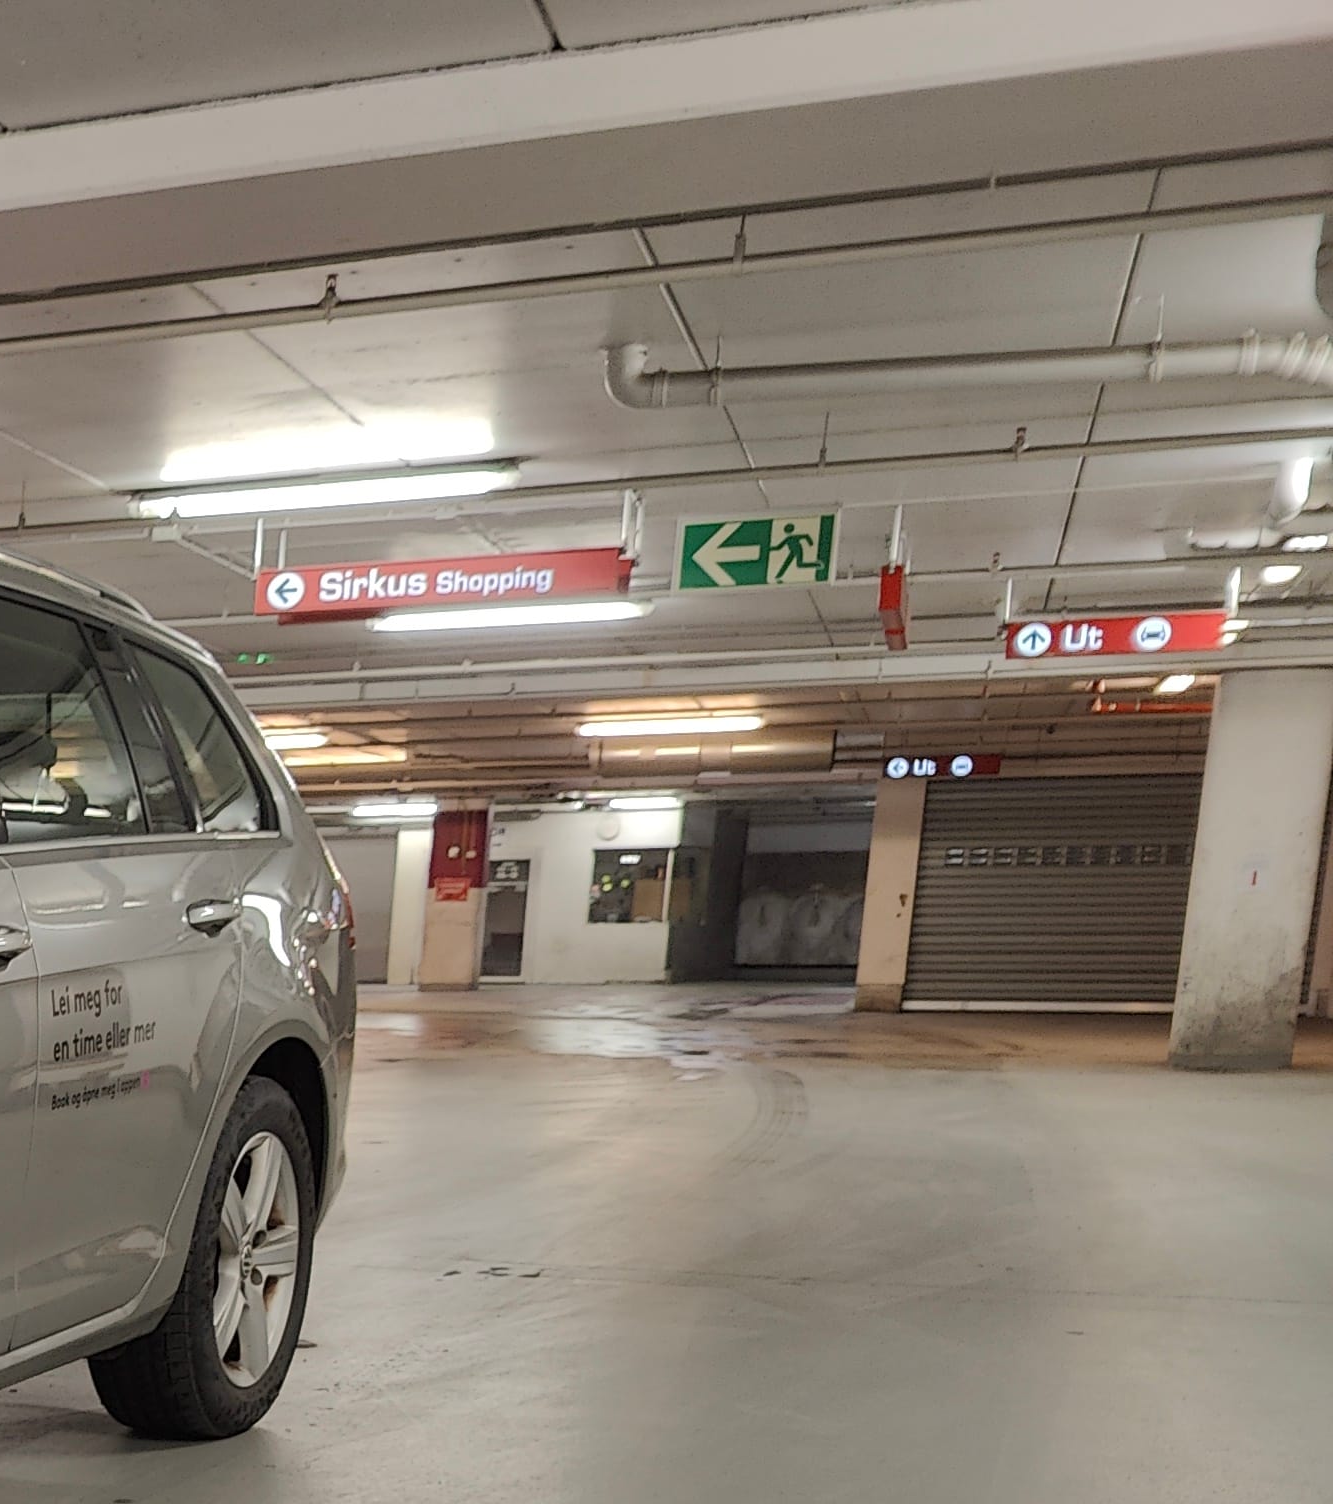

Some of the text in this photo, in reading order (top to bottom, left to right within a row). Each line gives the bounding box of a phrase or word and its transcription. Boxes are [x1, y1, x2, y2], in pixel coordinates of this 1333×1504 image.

[318, 565, 555, 602] Sirkus Shopping
[1061, 622, 1104, 653] Ut
[51, 979, 122, 1018] Lei meg for
[53, 1021, 156, 1062] en time eller mer
[51, 1092, 69, 1111] Book
[71, 1093, 81, 1109] og
[101, 1083, 116, 1100] meg
